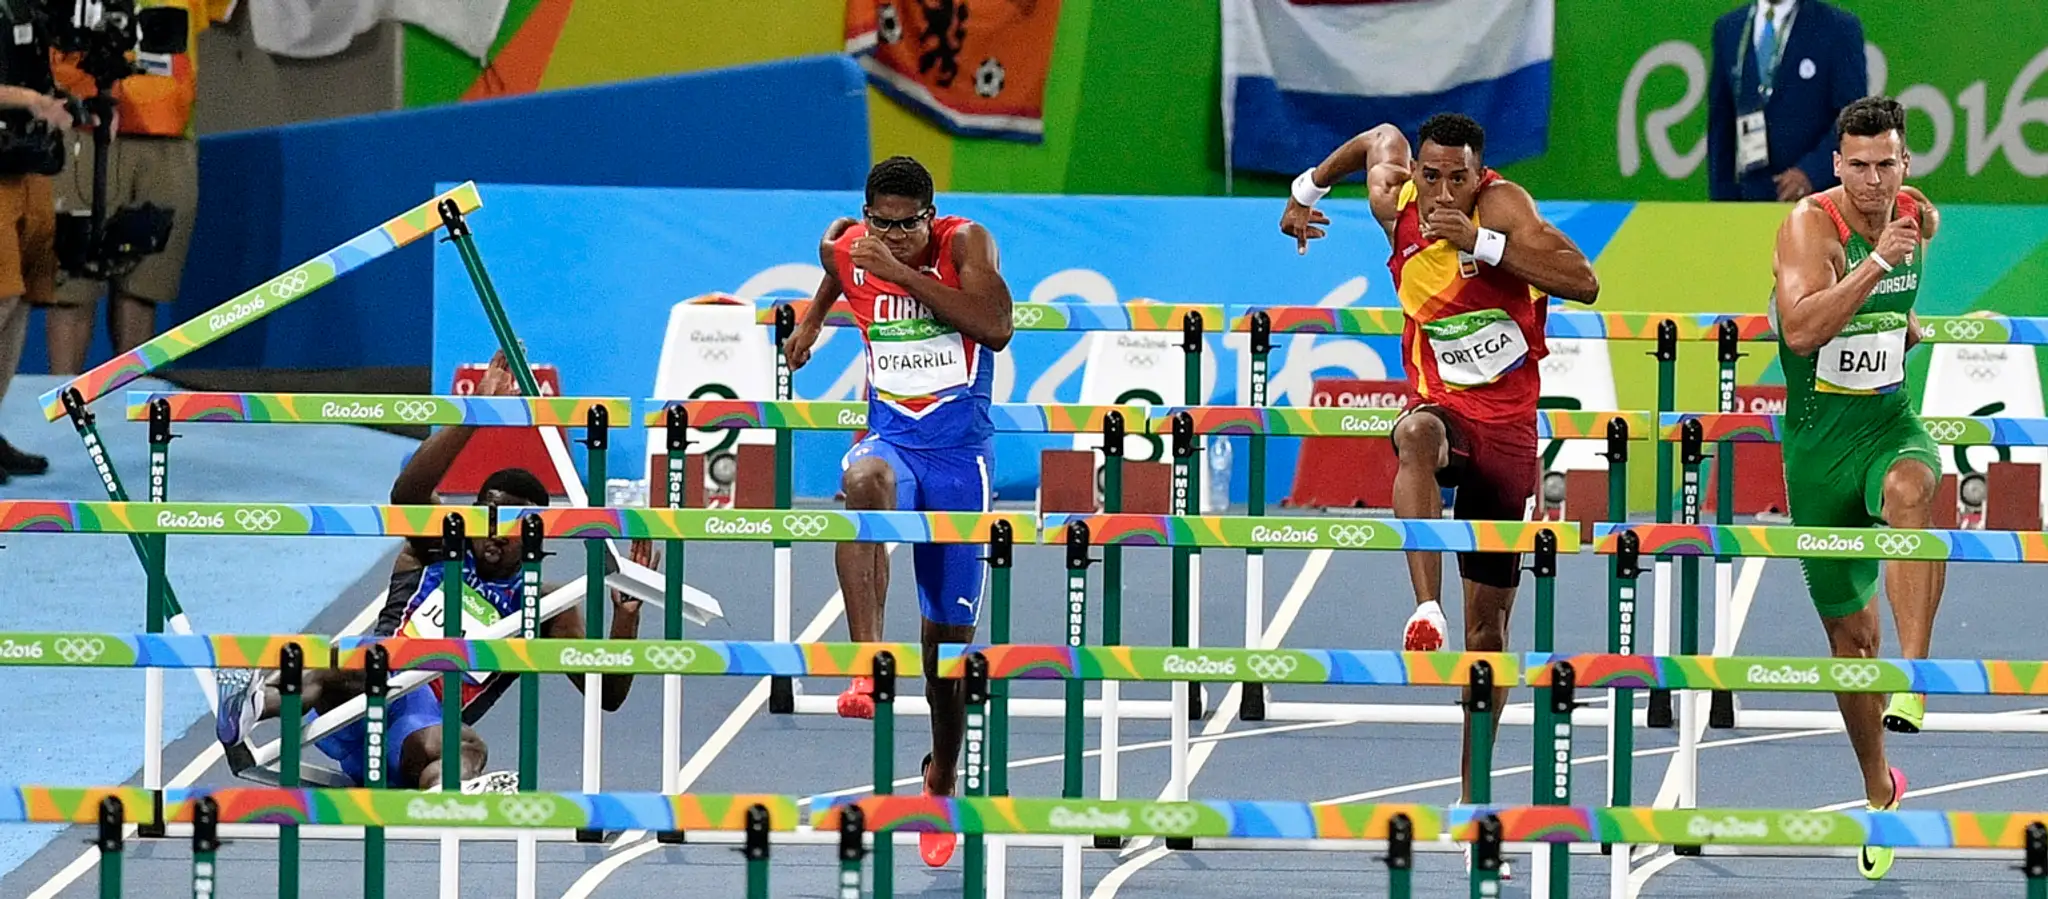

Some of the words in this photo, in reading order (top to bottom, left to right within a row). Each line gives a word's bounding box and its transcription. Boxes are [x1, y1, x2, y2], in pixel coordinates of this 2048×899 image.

[209, 294, 266, 332] Rio2016
[877, 350, 958, 371] O'FARRILL
[1441, 332, 1514, 366] ORTEGA
[1838, 350, 1887, 373] BAJI
[321, 402, 384, 419] Rio2016
[1341, 415, 1397, 431] Rio201
[89, 443, 118, 493] MONDO
[156, 510, 224, 529] Rio2016
[704, 516, 773, 535] Rio2016
[1251, 525, 1319, 544] Rio2016
[1796, 533, 1865, 552] Rio2016
[523, 585, 538, 639] MONDO
[1069, 591, 1084, 647] MONDO
[1619, 601, 1634, 657] MONDO
[560, 647, 635, 667] Rio2016
[1163, 655, 1236, 675] Rio2016
[1747, 664, 1820, 685] Rio2016
[368, 720, 384, 782] MONDO
[966, 728, 983, 789] MONDO
[1554, 738, 1570, 799] MONDO
[407, 798, 489, 822] Rio2016
[1048, 806, 1131, 829] Rio2016
[1687, 815, 1769, 838] Rio2016
